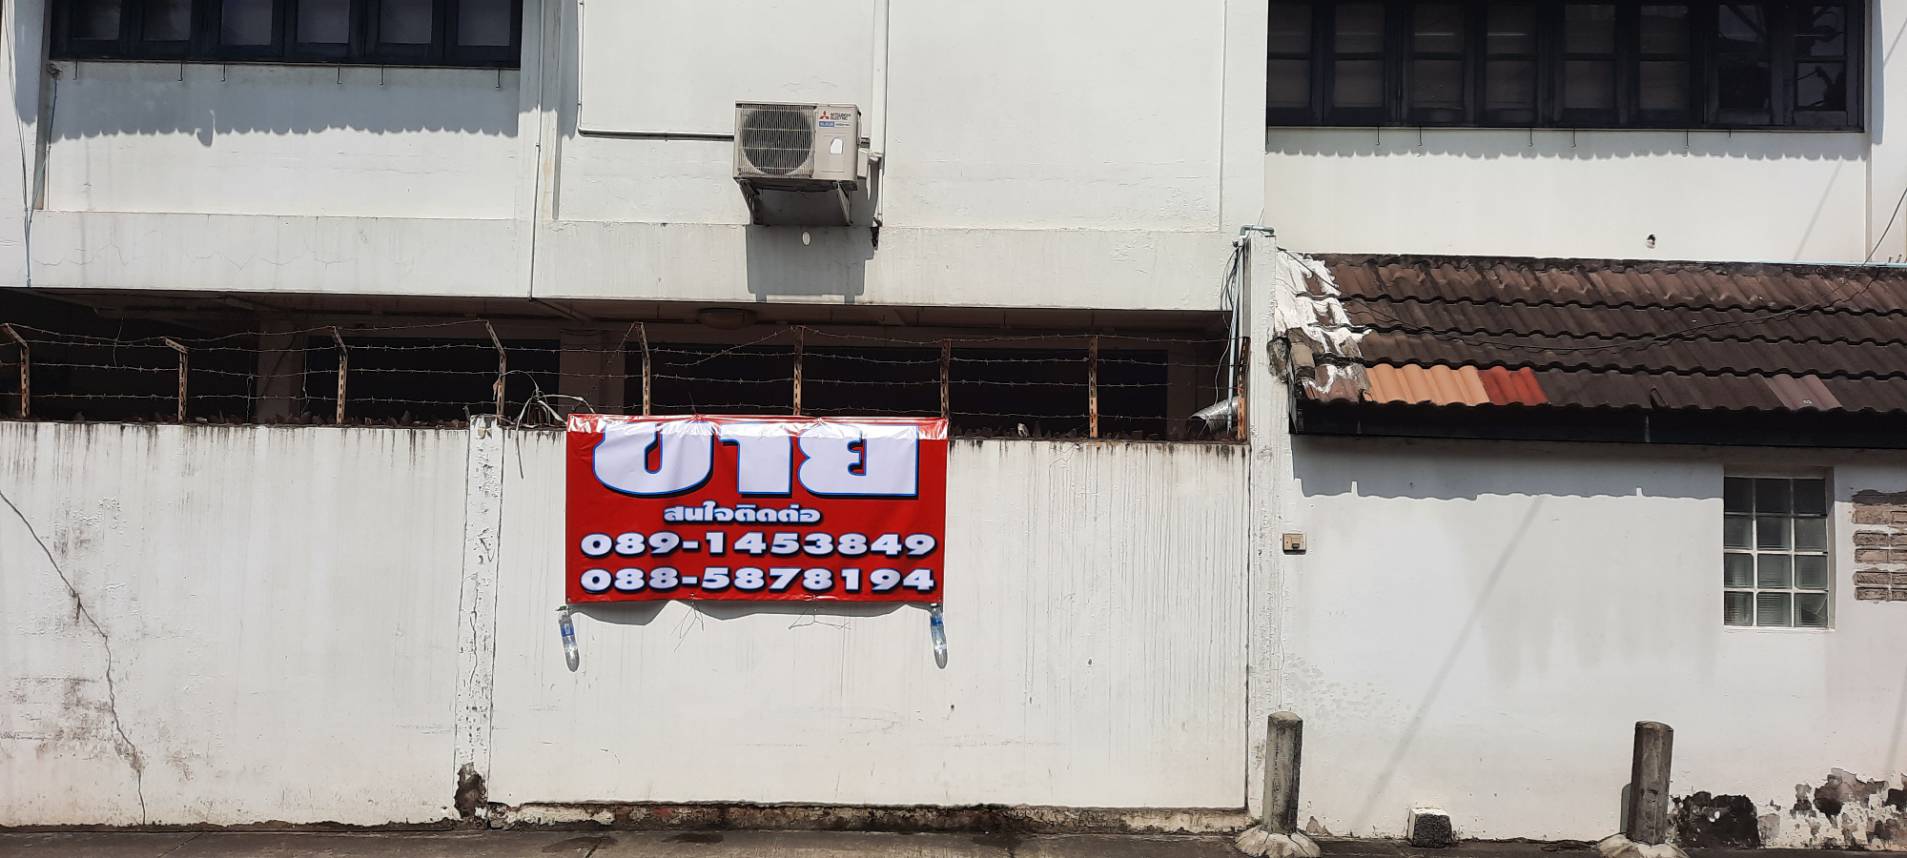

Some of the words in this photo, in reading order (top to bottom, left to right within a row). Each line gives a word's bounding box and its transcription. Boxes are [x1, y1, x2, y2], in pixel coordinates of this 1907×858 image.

[592, 422, 919, 497] ขาย
[663, 501, 821, 524] สนใจติดต่อ
[580, 531, 937, 557] 089-1453849
[580, 566, 936, 593] 088-5878194
